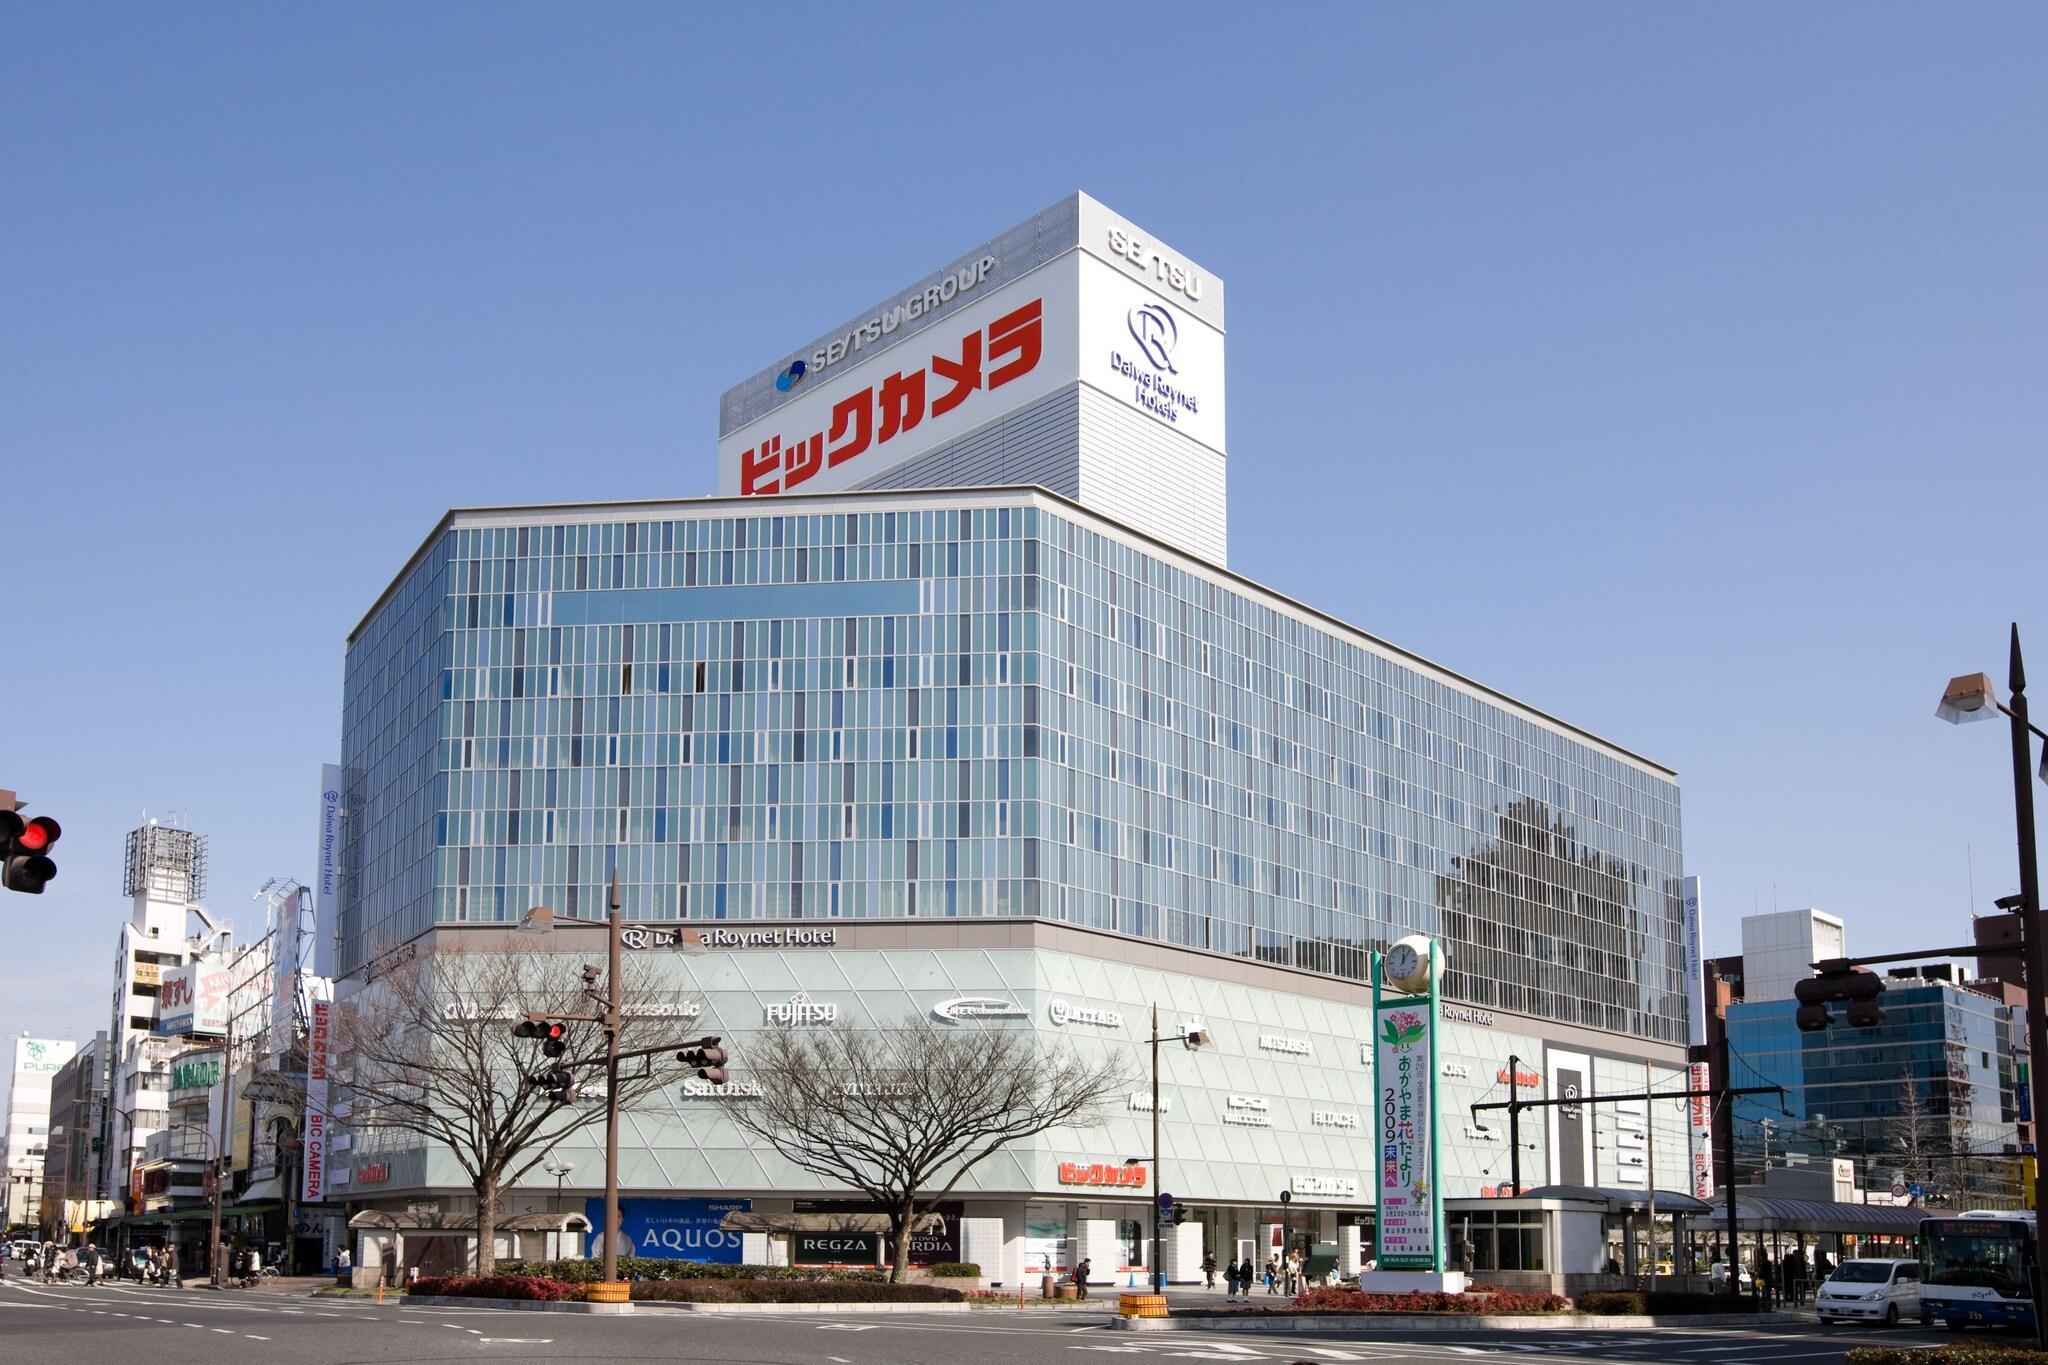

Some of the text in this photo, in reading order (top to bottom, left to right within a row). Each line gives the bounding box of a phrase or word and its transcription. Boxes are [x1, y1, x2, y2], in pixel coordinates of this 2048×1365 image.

[905, 254, 995, 320] GROUP
[741, 297, 1043, 496] ビックカメラ
[1111, 350, 1198, 415] Daiwa Roynet
[322, 805, 336, 895] Daiwa Roynet Hotel
[714, 928, 781, 948] Roynet
[785, 927, 837, 944] Hotel
[1442, 1004, 1494, 1027] Roynet Hotel
[1398, 1055, 1413, 1188] おかやま花だより
[307, 1115, 323, 1199] BIC CAMERA
[1060, 1162, 1147, 1187] ビックカメラ
[642, 1228, 741, 1252] AQUOS
[804, 1239, 867, 1250] REGZA
